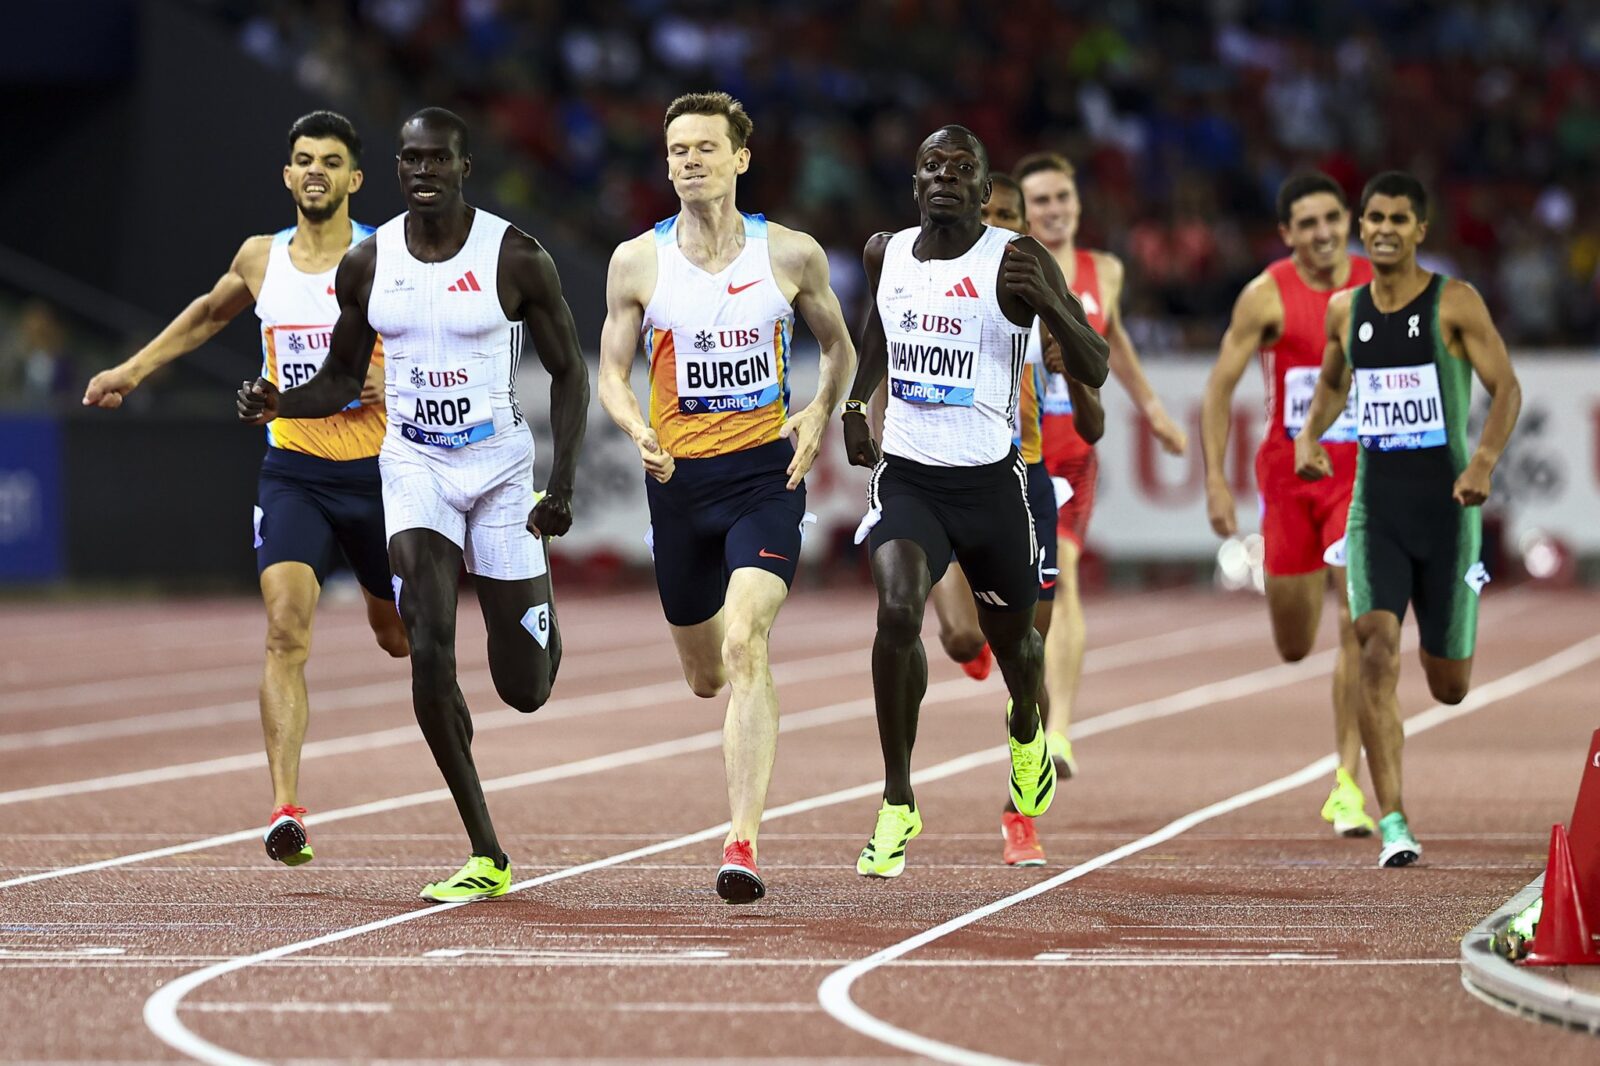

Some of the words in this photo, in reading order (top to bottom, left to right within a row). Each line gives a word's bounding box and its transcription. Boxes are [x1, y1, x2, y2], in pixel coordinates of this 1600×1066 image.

[921, 314, 963, 336] UBS
[307, 332, 334, 350] UB
[718, 328, 760, 348] UBS
[686, 351, 770, 389] BURGIN
[890, 341, 974, 380] WANYONYI
[428, 368, 468, 388] UBS
[1385, 372, 1421, 390] UBS
[901, 383, 946, 400] ZURICH
[413, 397, 471, 426] AROP
[707, 394, 758, 410] ZURICH
[1362, 397, 1438, 427] ATTAOUI
[422, 431, 469, 446] ZURICH
[538, 610, 547, 632] 6
